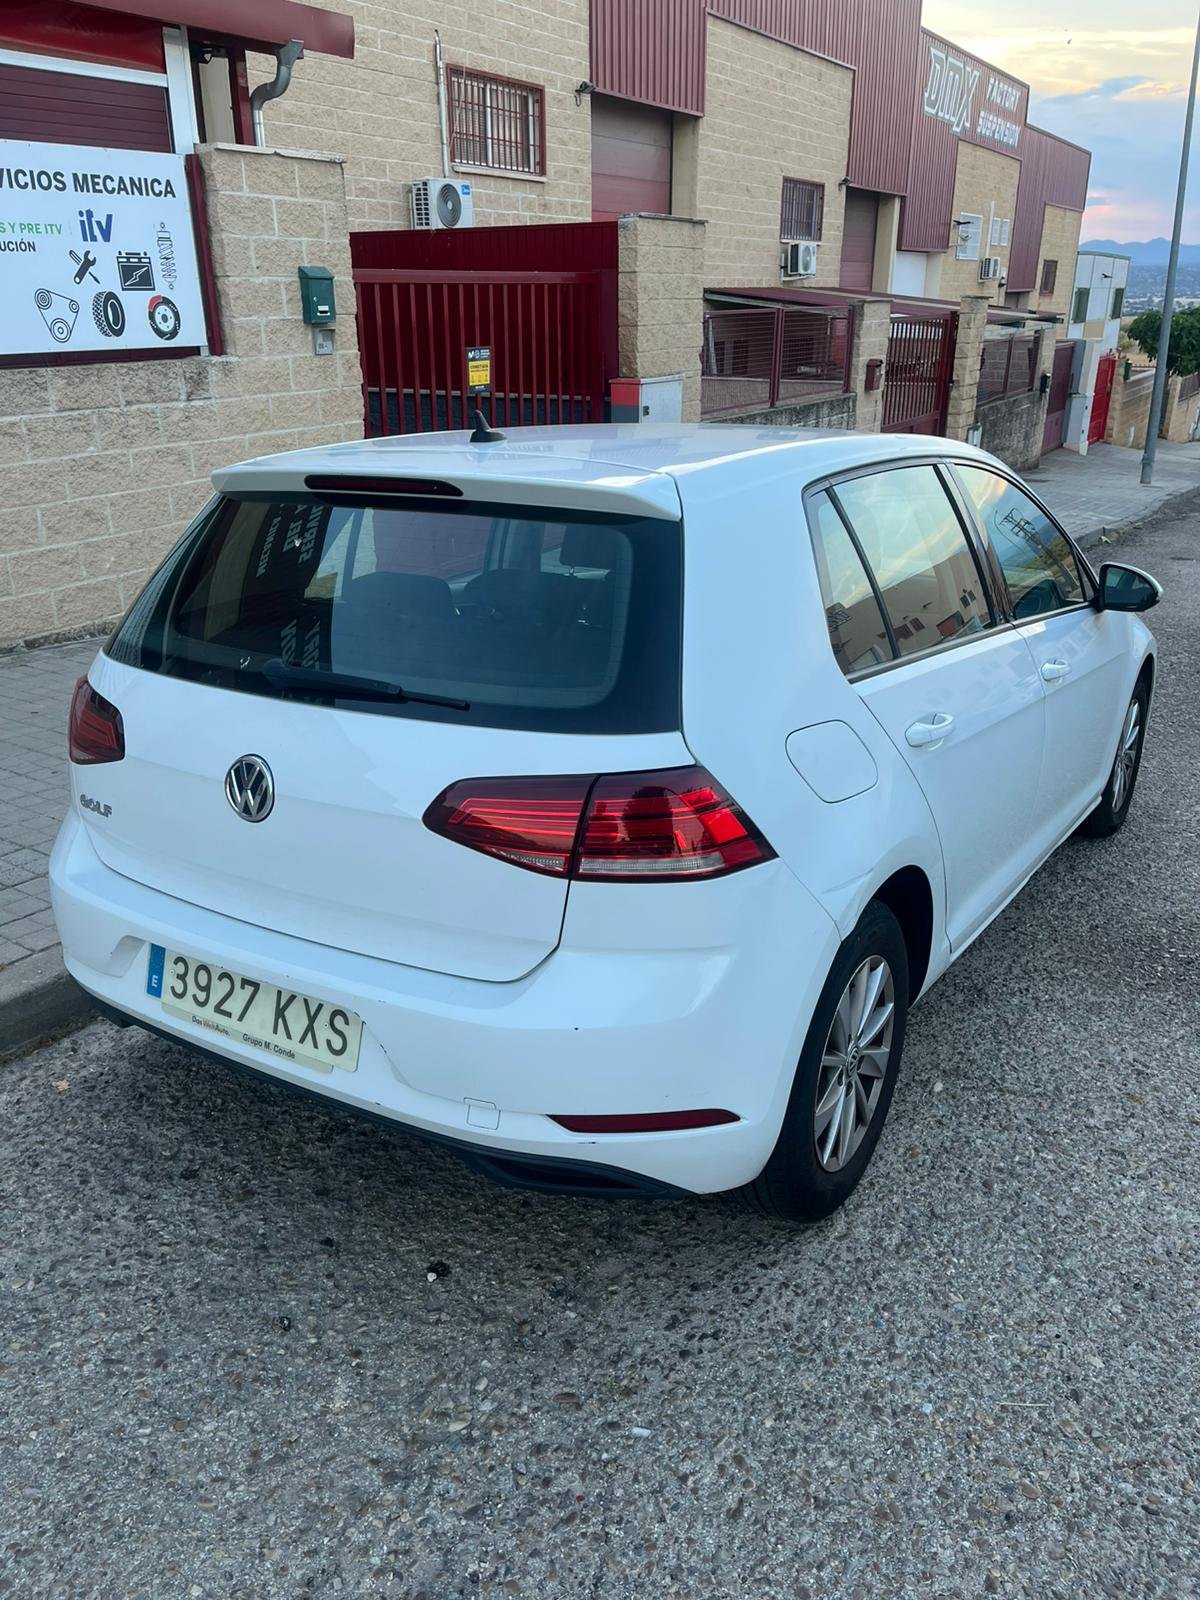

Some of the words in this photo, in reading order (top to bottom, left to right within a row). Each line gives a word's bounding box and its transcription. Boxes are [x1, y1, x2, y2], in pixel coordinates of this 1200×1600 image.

[924, 47, 980, 133] DMX
[986, 77, 1020, 112] FACTORY
[977, 110, 1021, 148] SUSPENSION
[72, 172, 176, 199] MECANICA
[8, 222, 16, 233] Y
[19, 222, 42, 234] PRE
[44, 223, 62, 235] ITV
[80, 794, 113, 818] GOLF
[151, 974, 159, 988] E
[170, 956, 261, 1023] 3927
[272, 989, 350, 1057] KXS
[242, 1033, 263, 1048] Grupo
[273, 1044, 296, 1059] Conde
